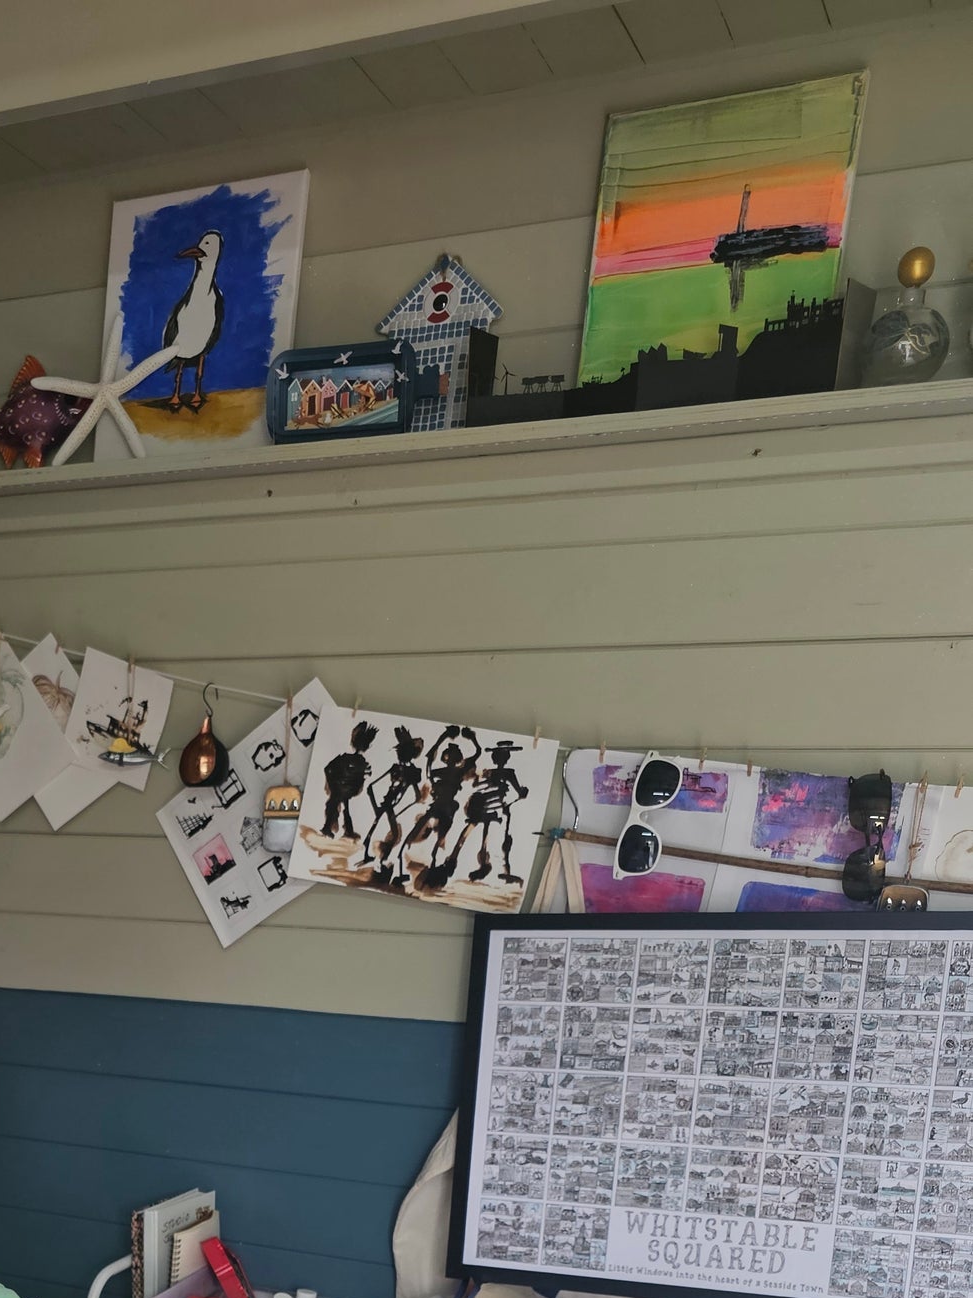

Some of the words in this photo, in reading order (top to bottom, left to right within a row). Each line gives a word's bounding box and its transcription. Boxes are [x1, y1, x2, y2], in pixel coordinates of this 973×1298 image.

[625, 1211, 819, 1251] WHITSTABLE
[647, 1240, 786, 1275] SQUARED
[608, 1263, 633, 1275] Little
[636, 1266, 673, 1278] Windows
[676, 1270, 695, 1280] into
[697, 1271, 712, 1282] the
[715, 1274, 739, 1286] heart
[742, 1277, 754, 1288] of
[763, 1280, 797, 1292] Seaside
[800, 1282, 824, 1294] Town
